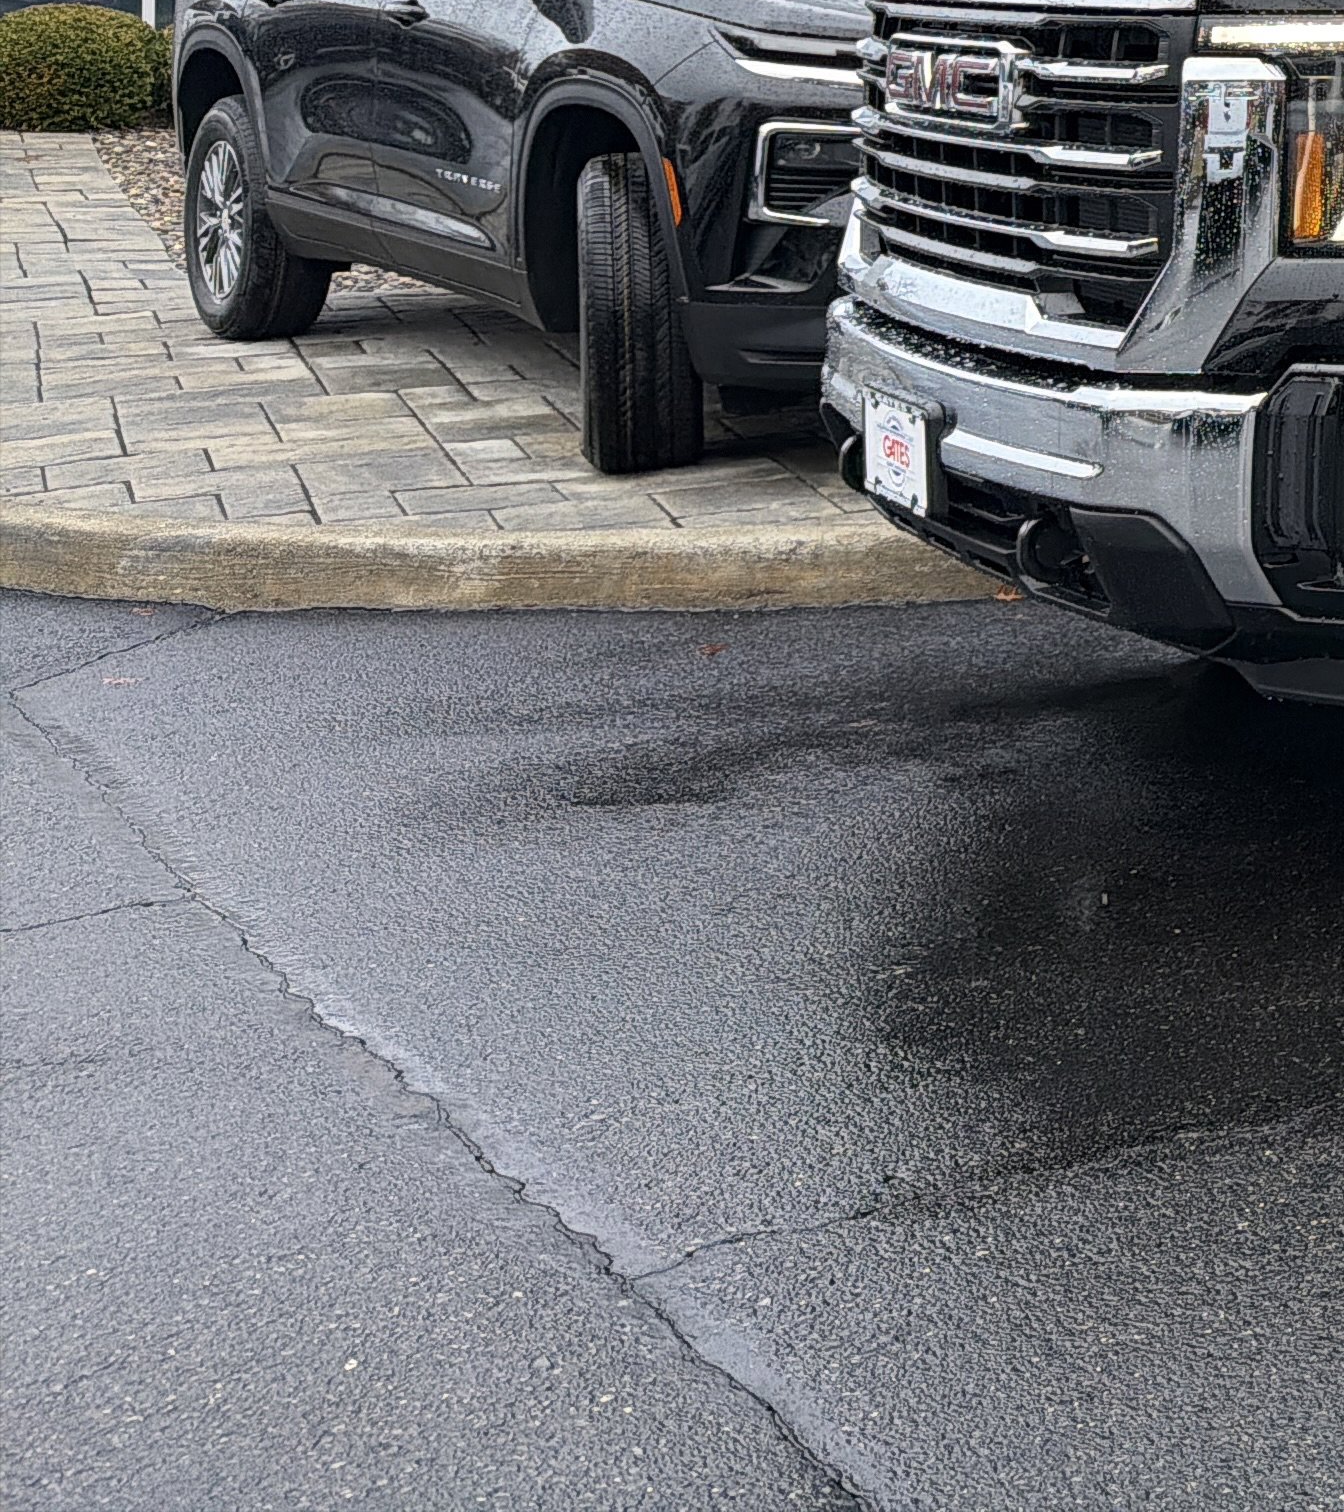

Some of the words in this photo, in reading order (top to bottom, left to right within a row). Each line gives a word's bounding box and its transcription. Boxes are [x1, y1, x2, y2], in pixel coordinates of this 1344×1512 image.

[886, 50, 999, 116] GMC
[435, 168, 502, 194] TRAVERSE
[882, 434, 911, 469] GATES
